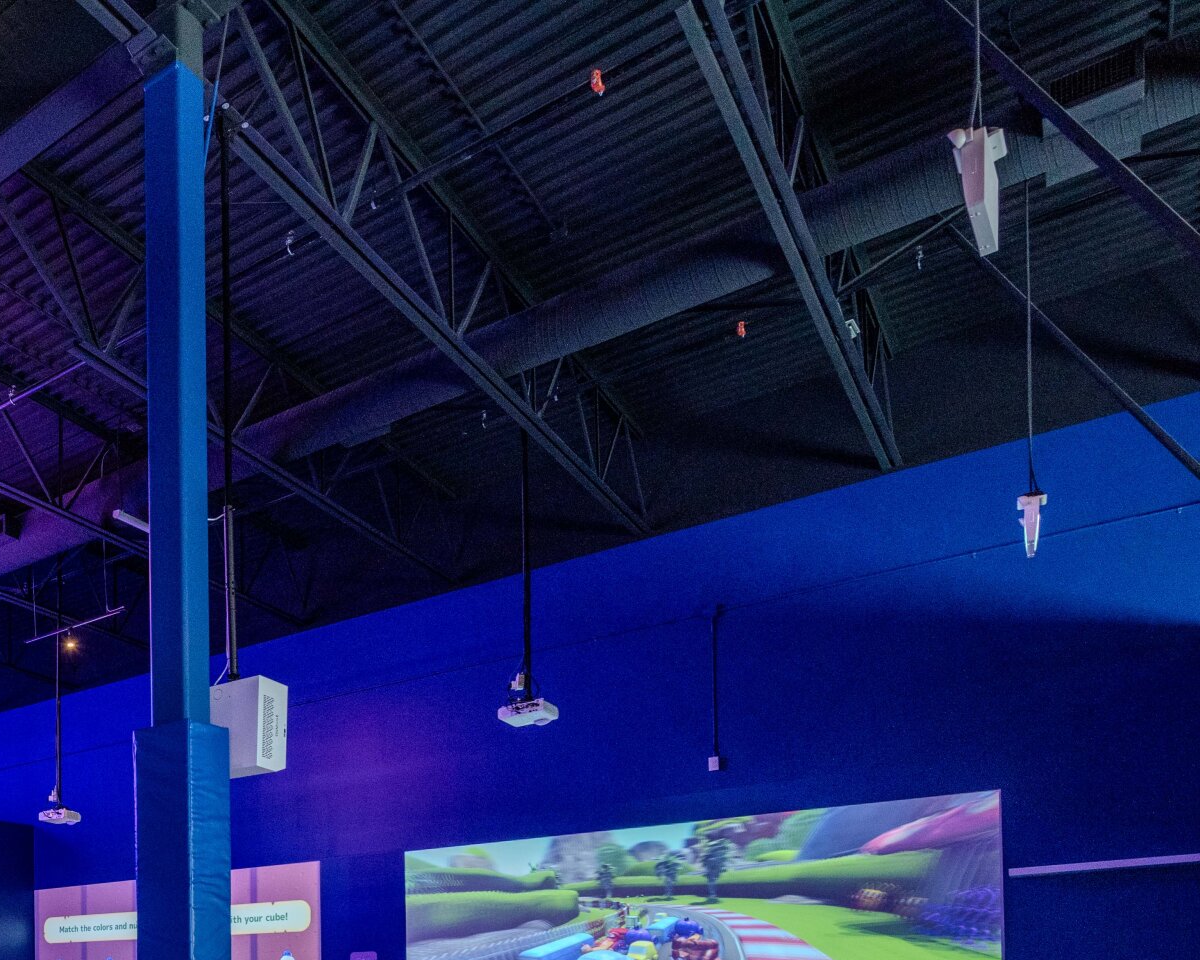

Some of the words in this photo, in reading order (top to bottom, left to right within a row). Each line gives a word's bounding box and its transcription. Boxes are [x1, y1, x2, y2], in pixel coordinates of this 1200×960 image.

[59, 925, 79, 934] Match
[80, 924, 92, 932] the
[92, 923, 113, 931] colors
[114, 922, 127, 930] and
[230, 915, 242, 924] ith
[244, 915, 263, 925] your
[265, 912, 288, 922] cube!
